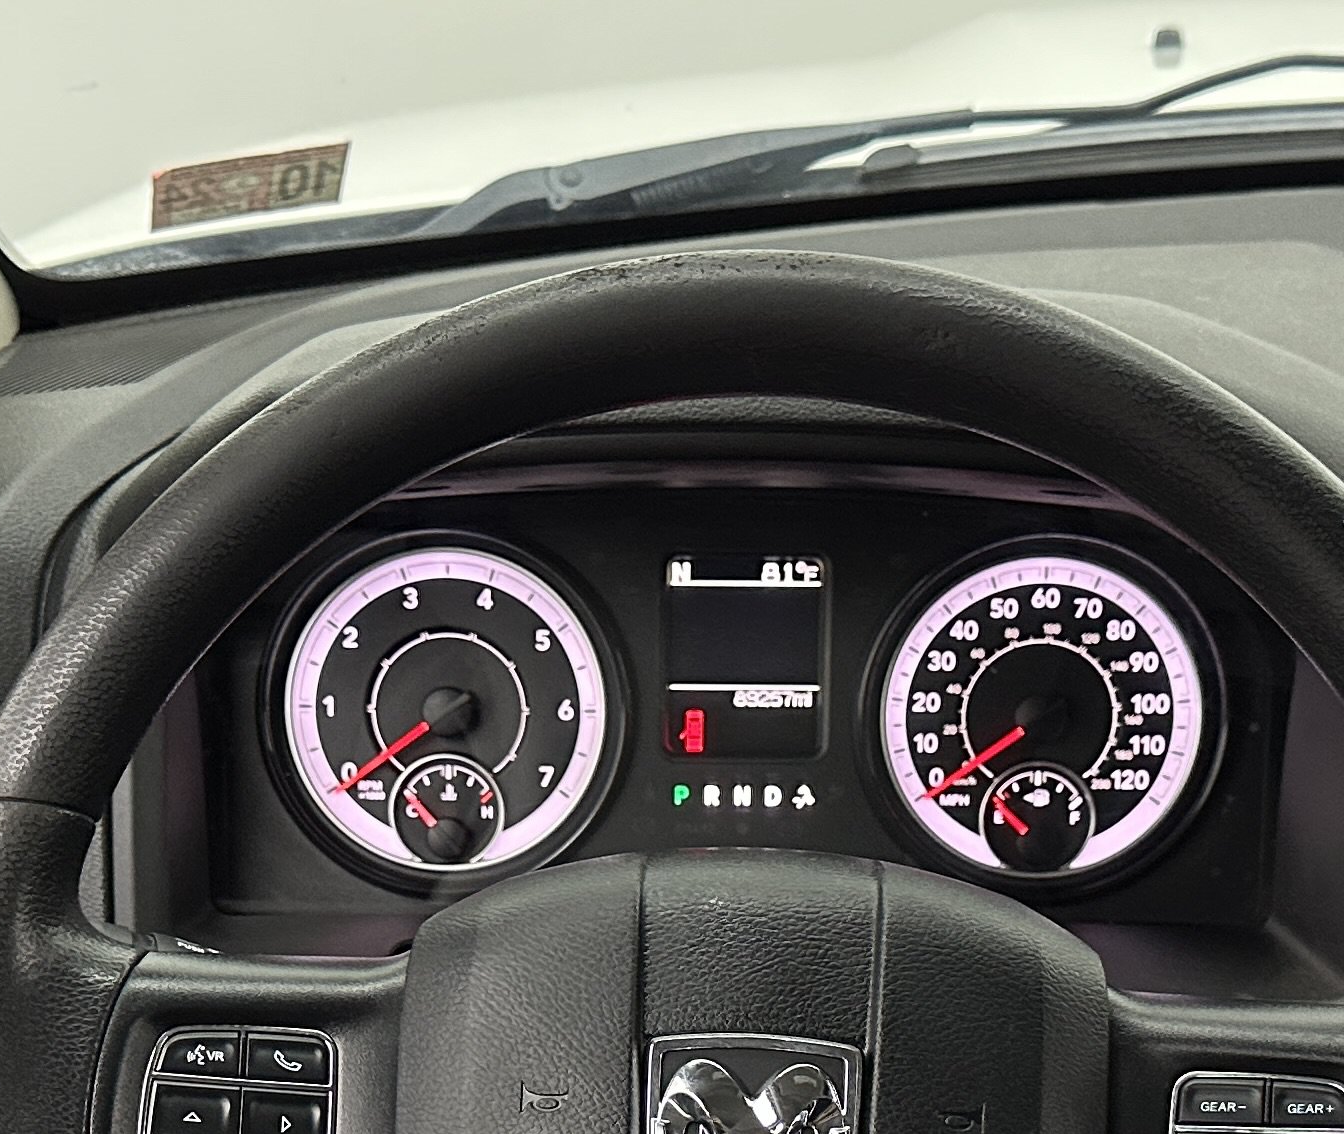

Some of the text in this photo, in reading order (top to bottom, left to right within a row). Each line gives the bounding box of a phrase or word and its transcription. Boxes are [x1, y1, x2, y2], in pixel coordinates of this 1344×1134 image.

[402, 586, 419, 610] 3
[476, 587, 494, 611] 4
[990, 598, 1019, 620] 50
[1031, 588, 1061, 610] 60
[1073, 598, 1103, 620] 70
[341, 625, 359, 649] 2
[534, 629, 552, 652] 5
[949, 619, 979, 641] 40
[1106, 619, 1136, 641] 80
[927, 650, 956, 672] 30
[1129, 651, 1159, 673] 90
[321, 694, 336, 718] 1
[556, 698, 576, 722] 6
[911, 691, 942, 713] 20
[1130, 693, 1171, 715] 100
[913, 732, 939, 754] 10
[1129, 734, 1166, 756] 110
[537, 765, 556, 788] 7
[928, 766, 945, 787] 0
[1110, 769, 1150, 790] 120
[672, 784, 783, 807] P R N D
[939, 793, 971, 807] MPH
[480, 805, 494, 820] H
[206, 1050, 225, 1062] VR
